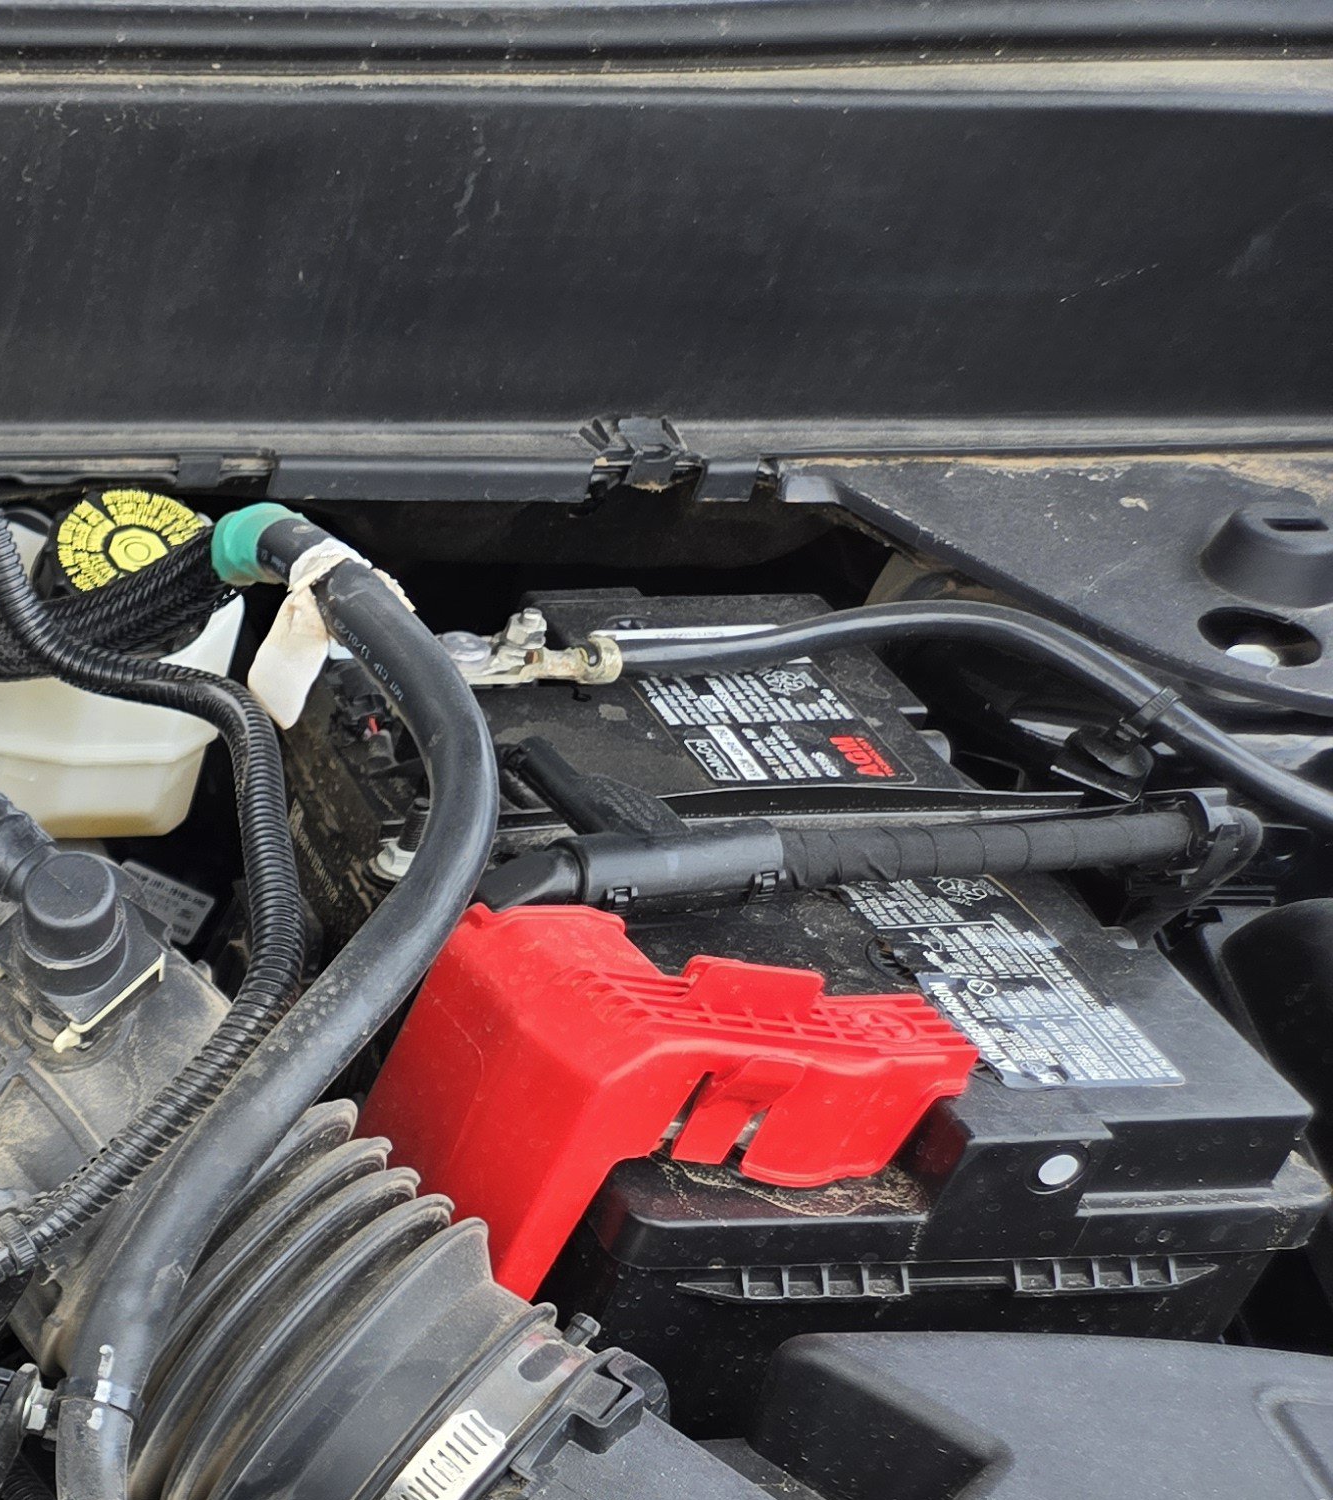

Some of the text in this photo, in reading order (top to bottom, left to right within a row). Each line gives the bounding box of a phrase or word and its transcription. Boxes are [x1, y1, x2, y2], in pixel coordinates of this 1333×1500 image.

[829, 736, 886, 777] AGM
[928, 981, 973, 1020] POISON
[961, 1020, 1007, 1060] DANGER
